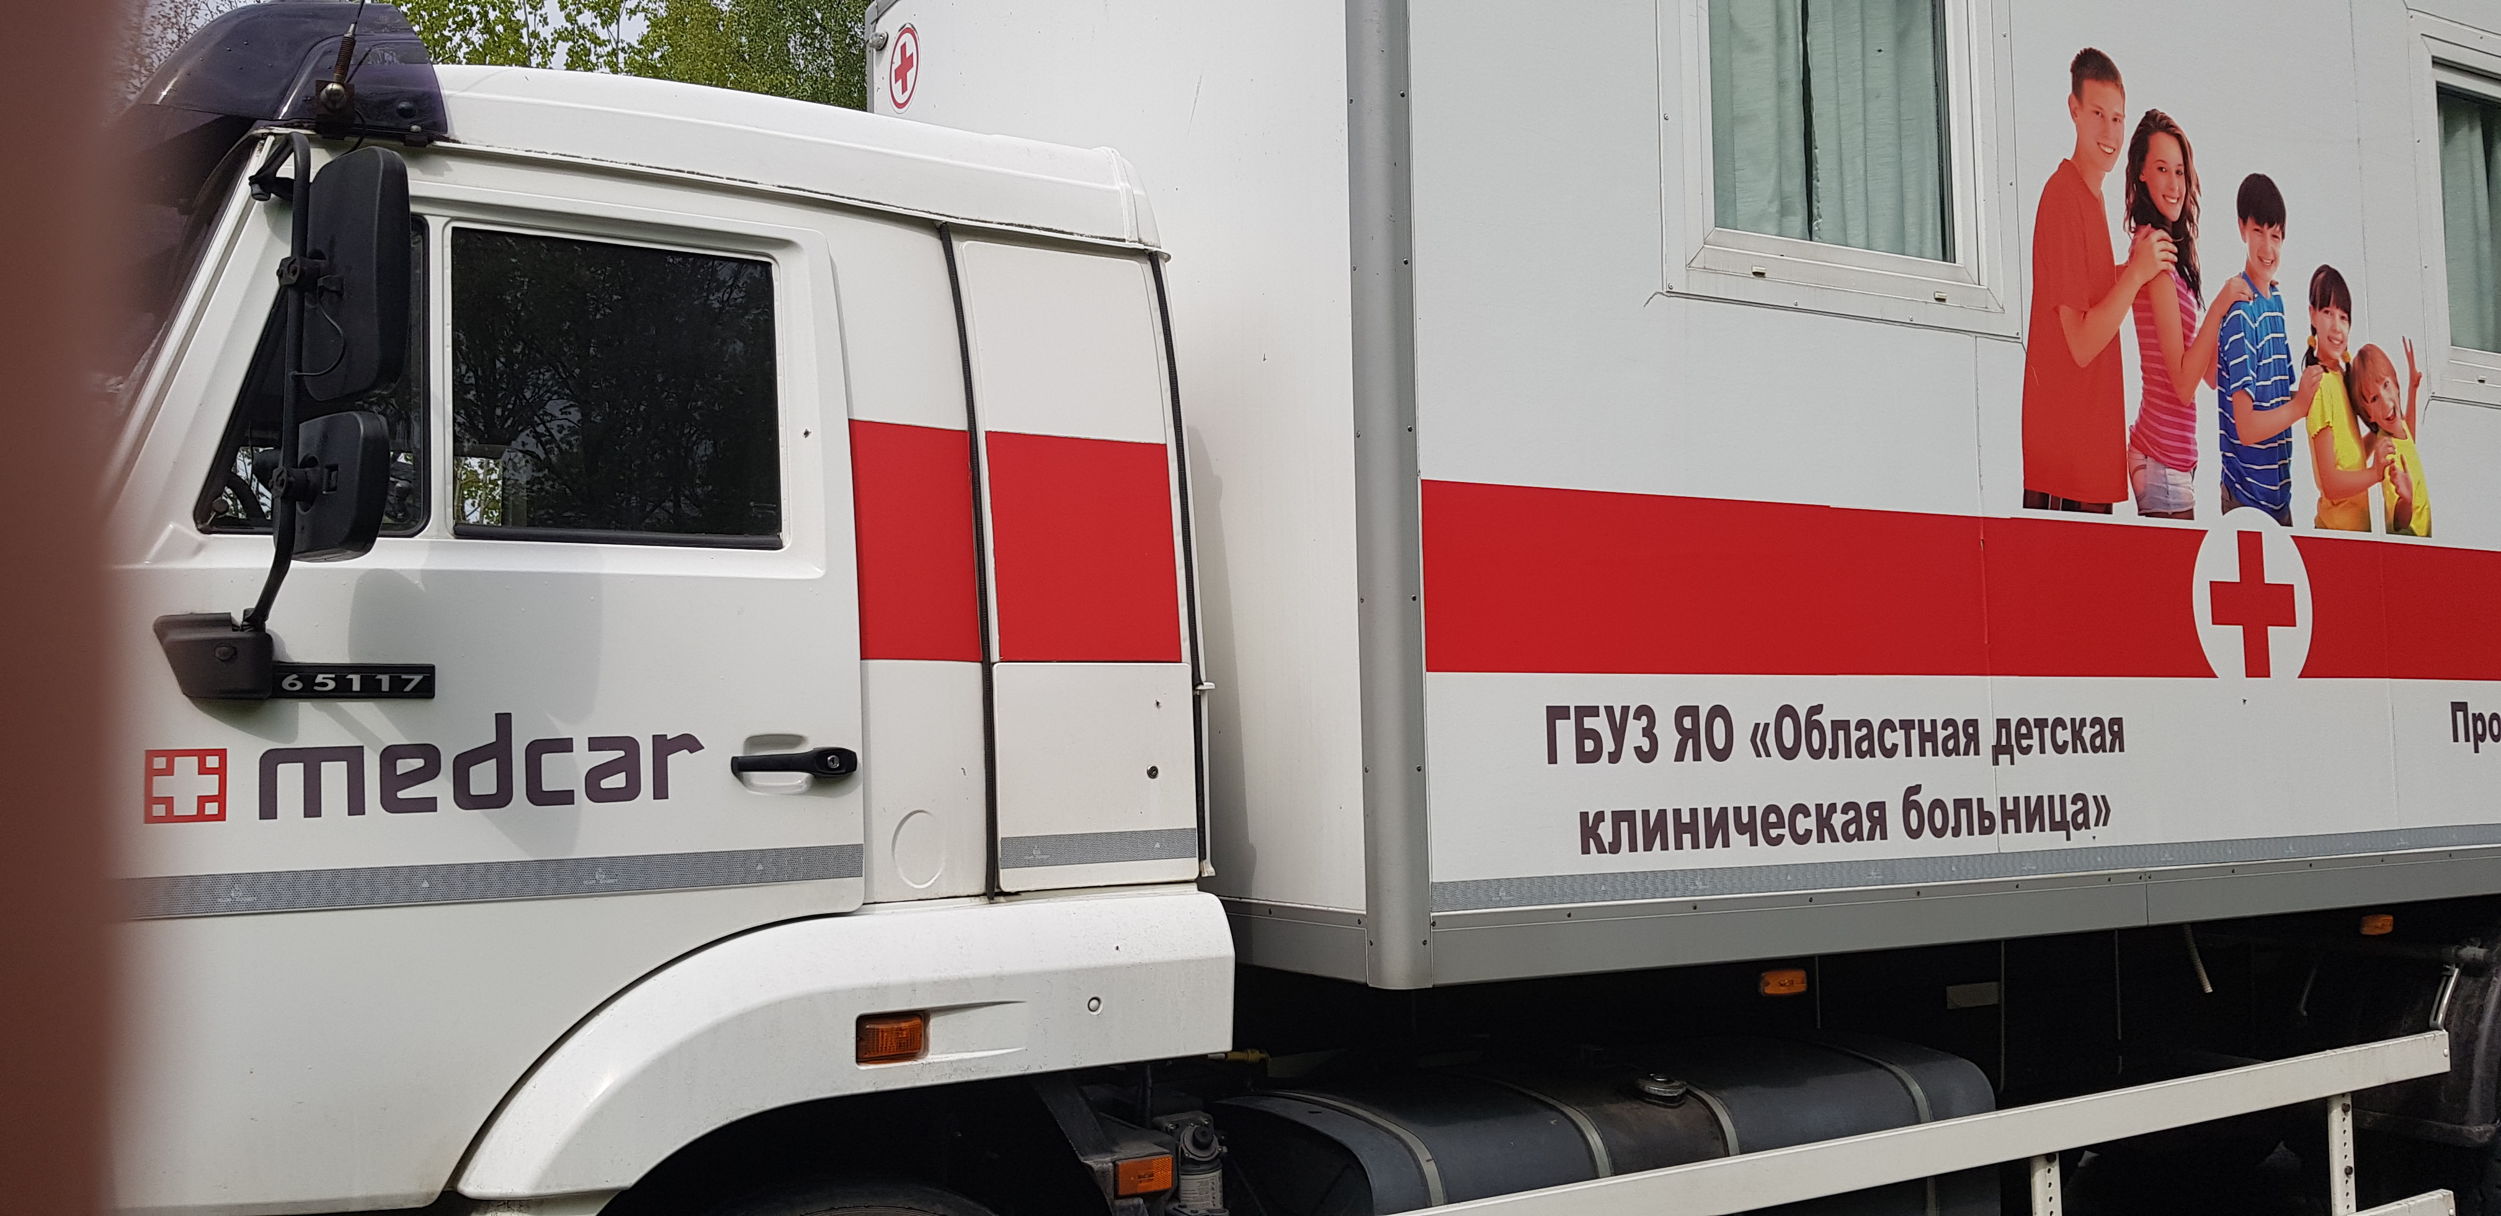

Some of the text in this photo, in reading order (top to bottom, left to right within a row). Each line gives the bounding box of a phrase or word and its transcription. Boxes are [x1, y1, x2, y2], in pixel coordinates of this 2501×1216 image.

[281, 673, 425, 692] 65117
[258, 712, 705, 821] medcar
[1545, 702, 2125, 767] ГБУЗ ЯО «Областная детская
[1579, 783, 2112, 856] клиническая больница»
